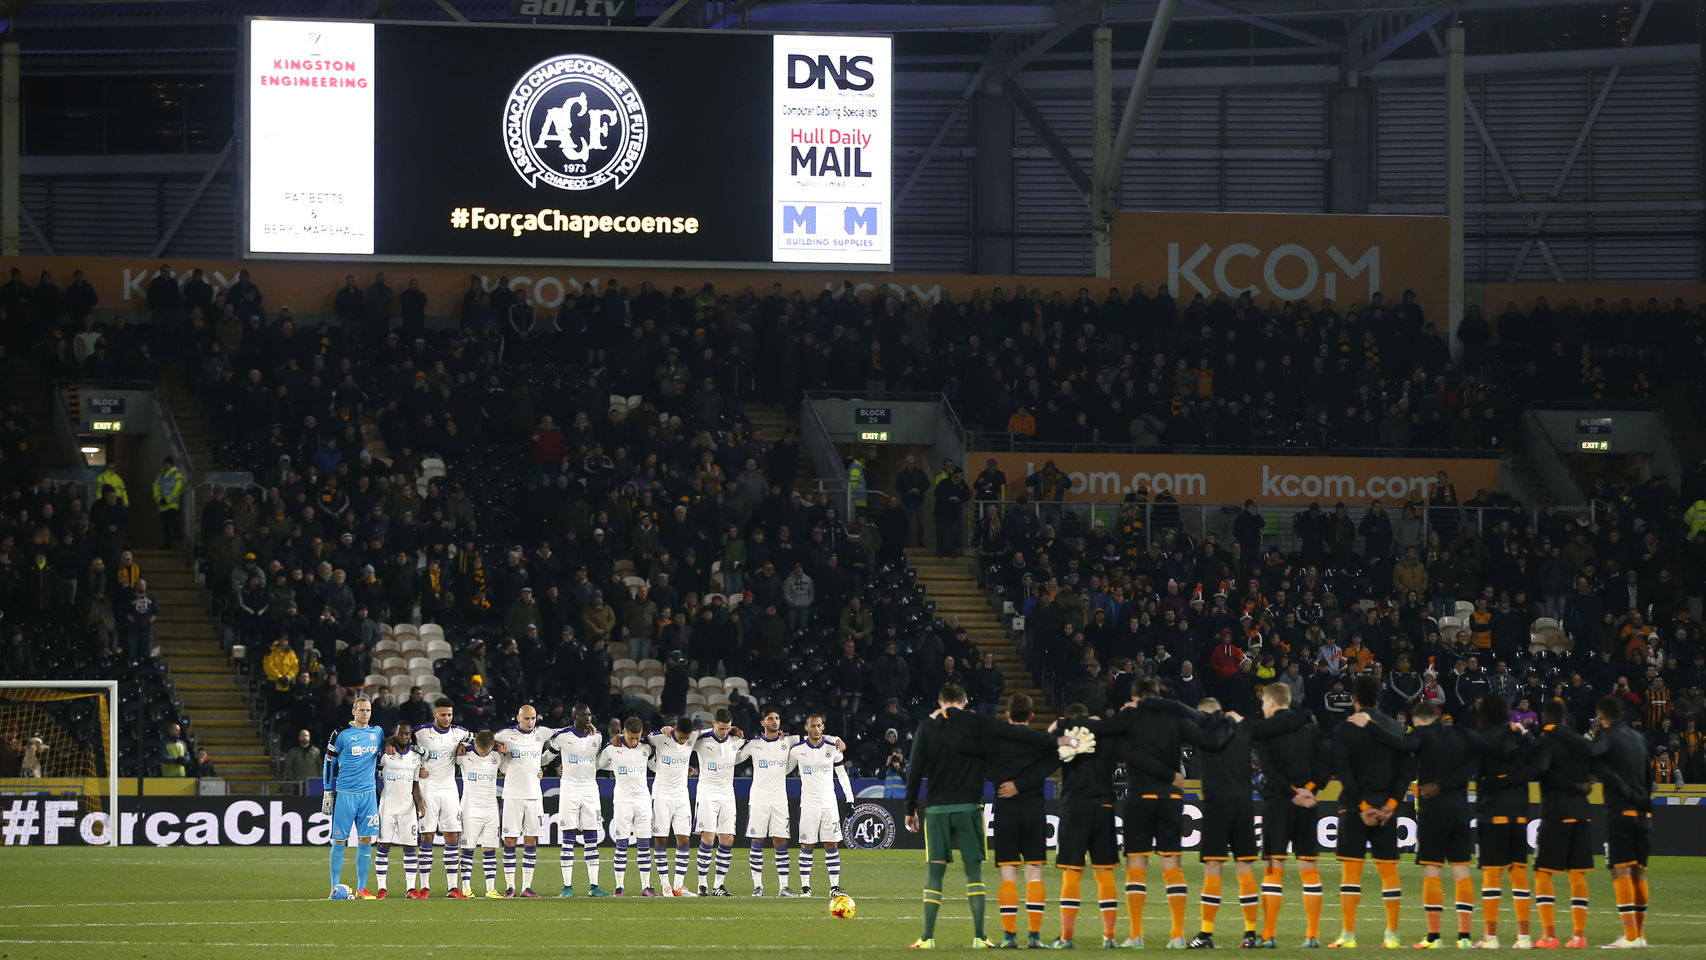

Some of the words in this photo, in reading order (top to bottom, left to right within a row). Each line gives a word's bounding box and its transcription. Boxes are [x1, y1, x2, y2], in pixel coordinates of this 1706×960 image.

[273, 59, 355, 71] KINGSTON
[787, 54, 874, 91] DNS
[260, 76, 368, 88] ENGINEERING
[528, 60, 629, 94] CHAPECOENSE
[622, 92, 641, 113] DE
[614, 114, 644, 175] FUTEBOL
[791, 128, 825, 144] Hull
[829, 129, 872, 149] Daily
[563, 164, 587, 173] 1973
[791, 146, 872, 177] MAIL
[450, 207, 699, 238] #ForçaChapecoense
[786, 237, 830, 246] BUILDING
[833, 239, 873, 247] SUPPLIES
[1168, 242, 1381, 300] KCOM
[92, 398, 119, 406] BLOCK
[93, 421, 112, 430] EXIT
[862, 432, 880, 440] EXIT
[1581, 441, 1600, 449] EXIT
[1262, 465, 1438, 498] kcom.com
[366, 813, 379, 827] 28
